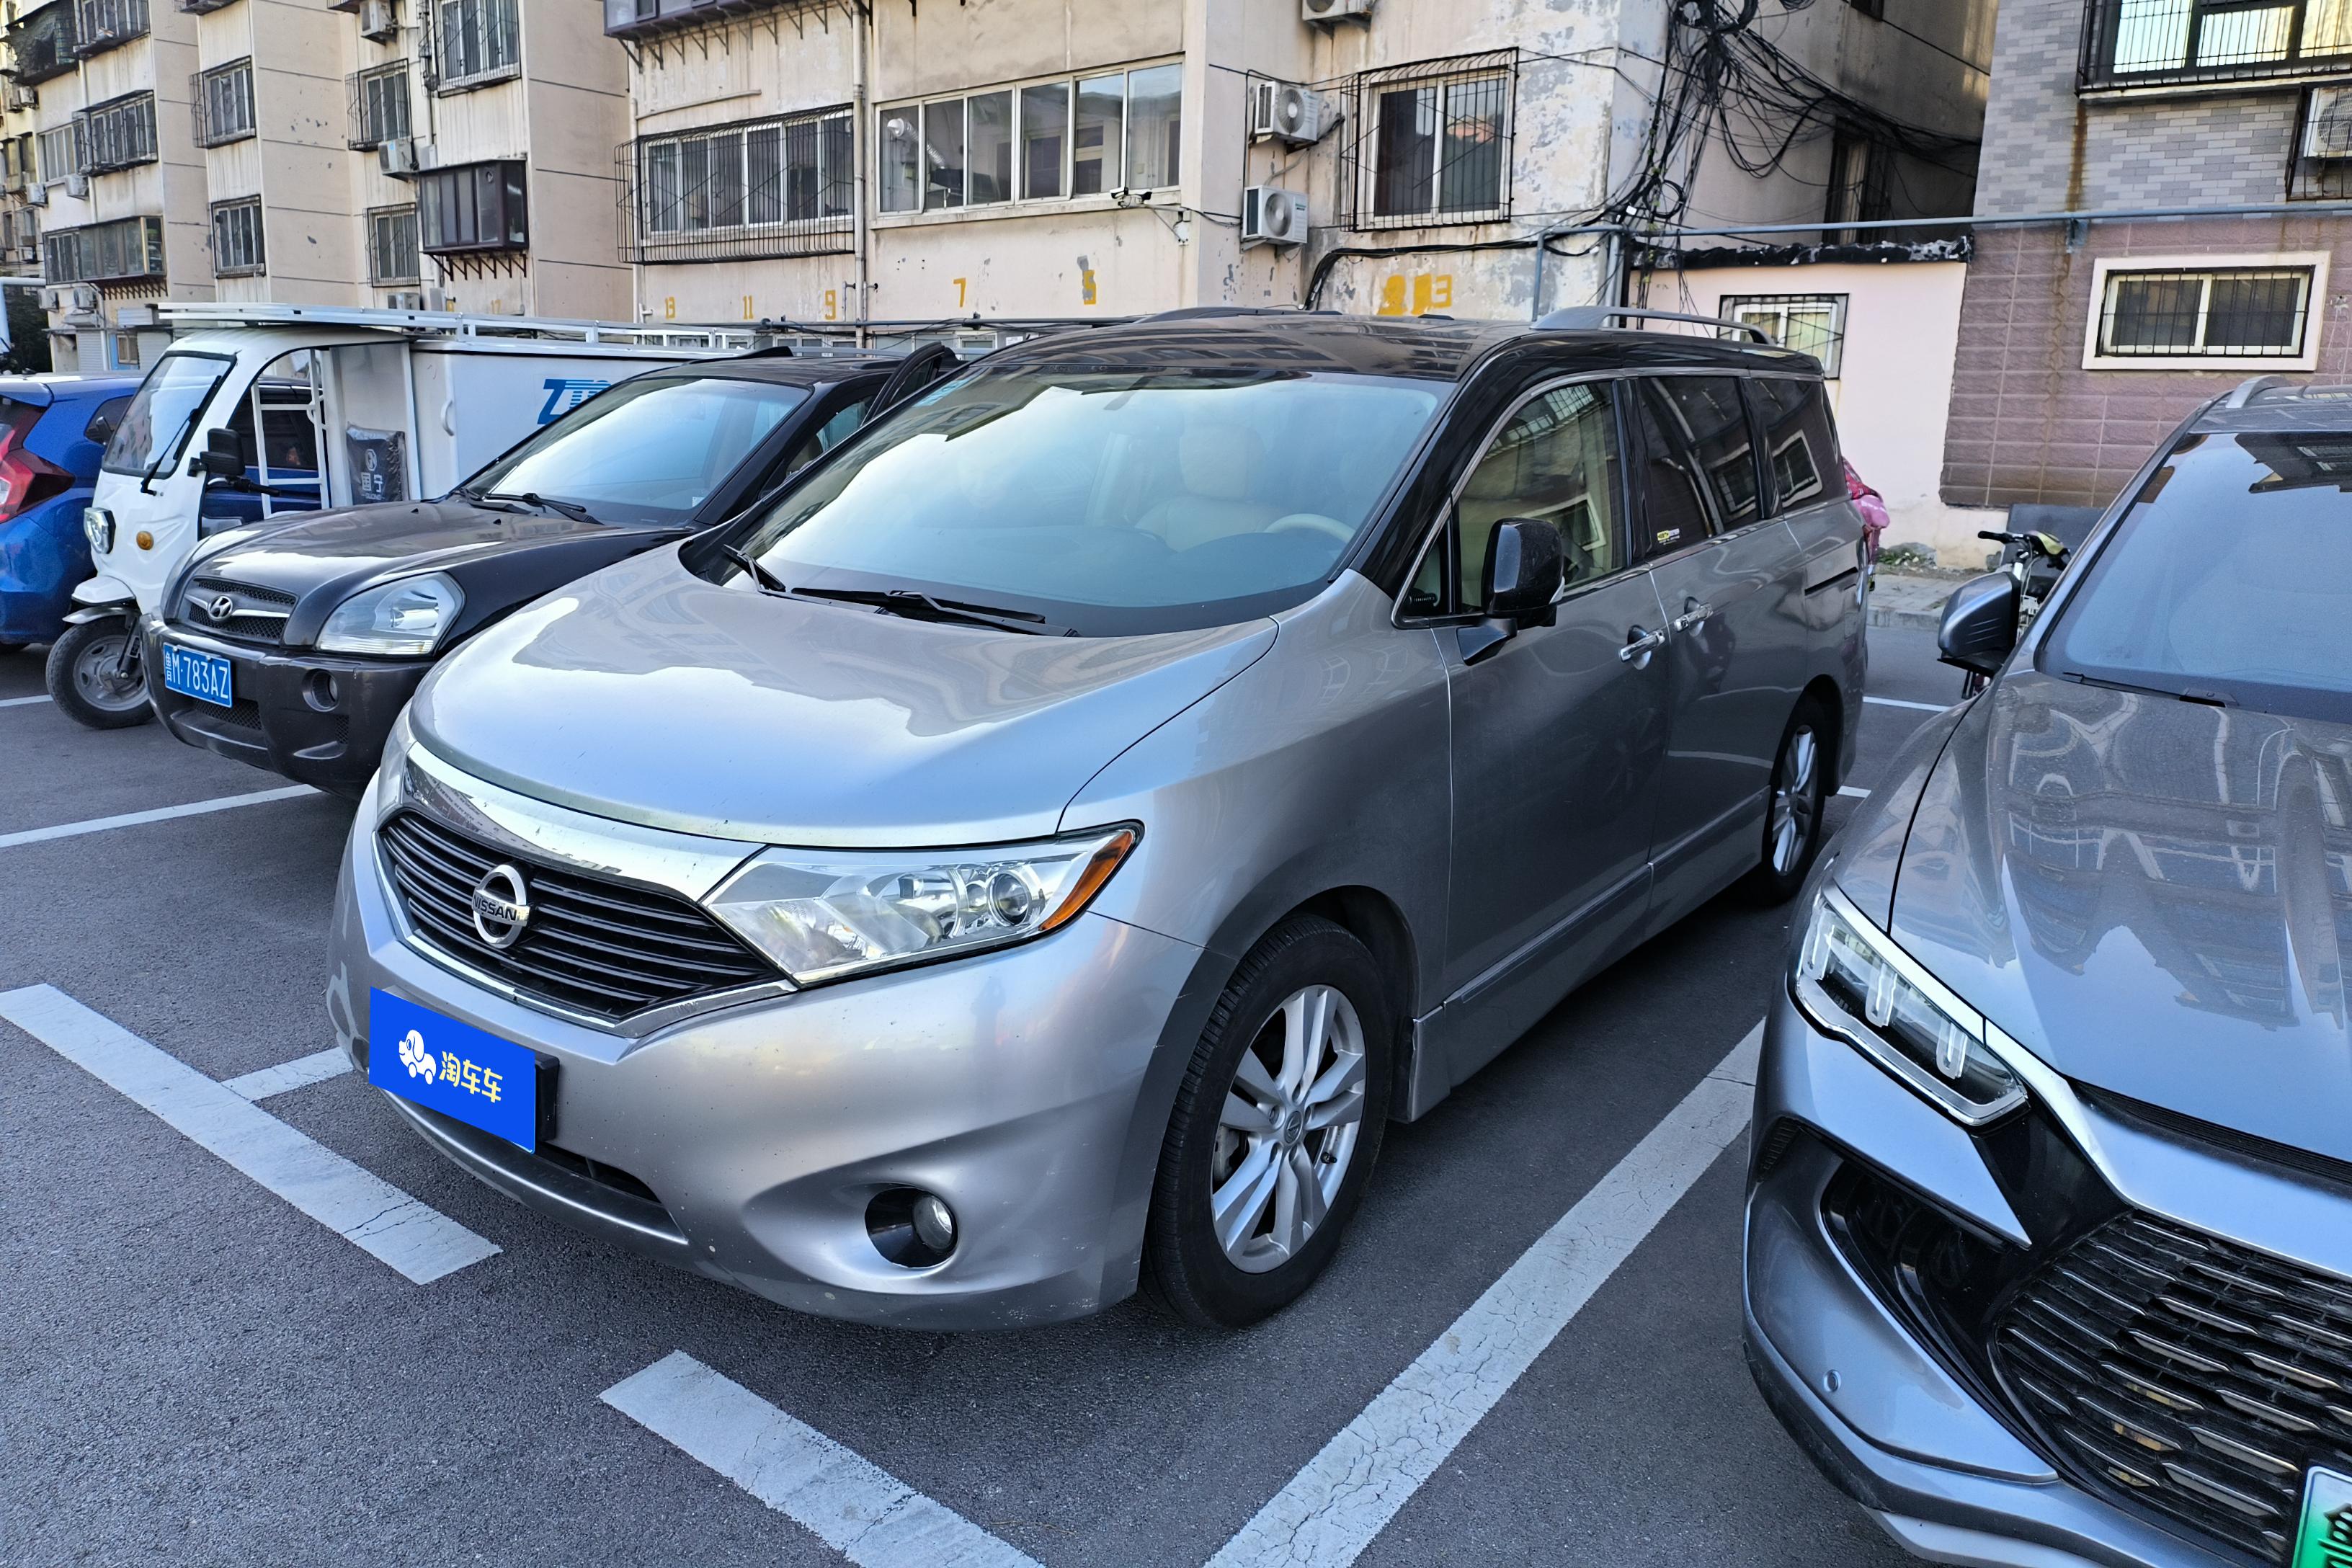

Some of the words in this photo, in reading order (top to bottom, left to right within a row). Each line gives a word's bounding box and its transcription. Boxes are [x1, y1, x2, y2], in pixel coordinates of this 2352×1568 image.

[825, 290, 836, 320] 9
[953, 277, 966, 308] 7
[665, 296, 675, 318] 13
[743, 295, 753, 319] 11
[538, 378, 611, 425] ZT
[473, 895, 517, 921] NISSAN
